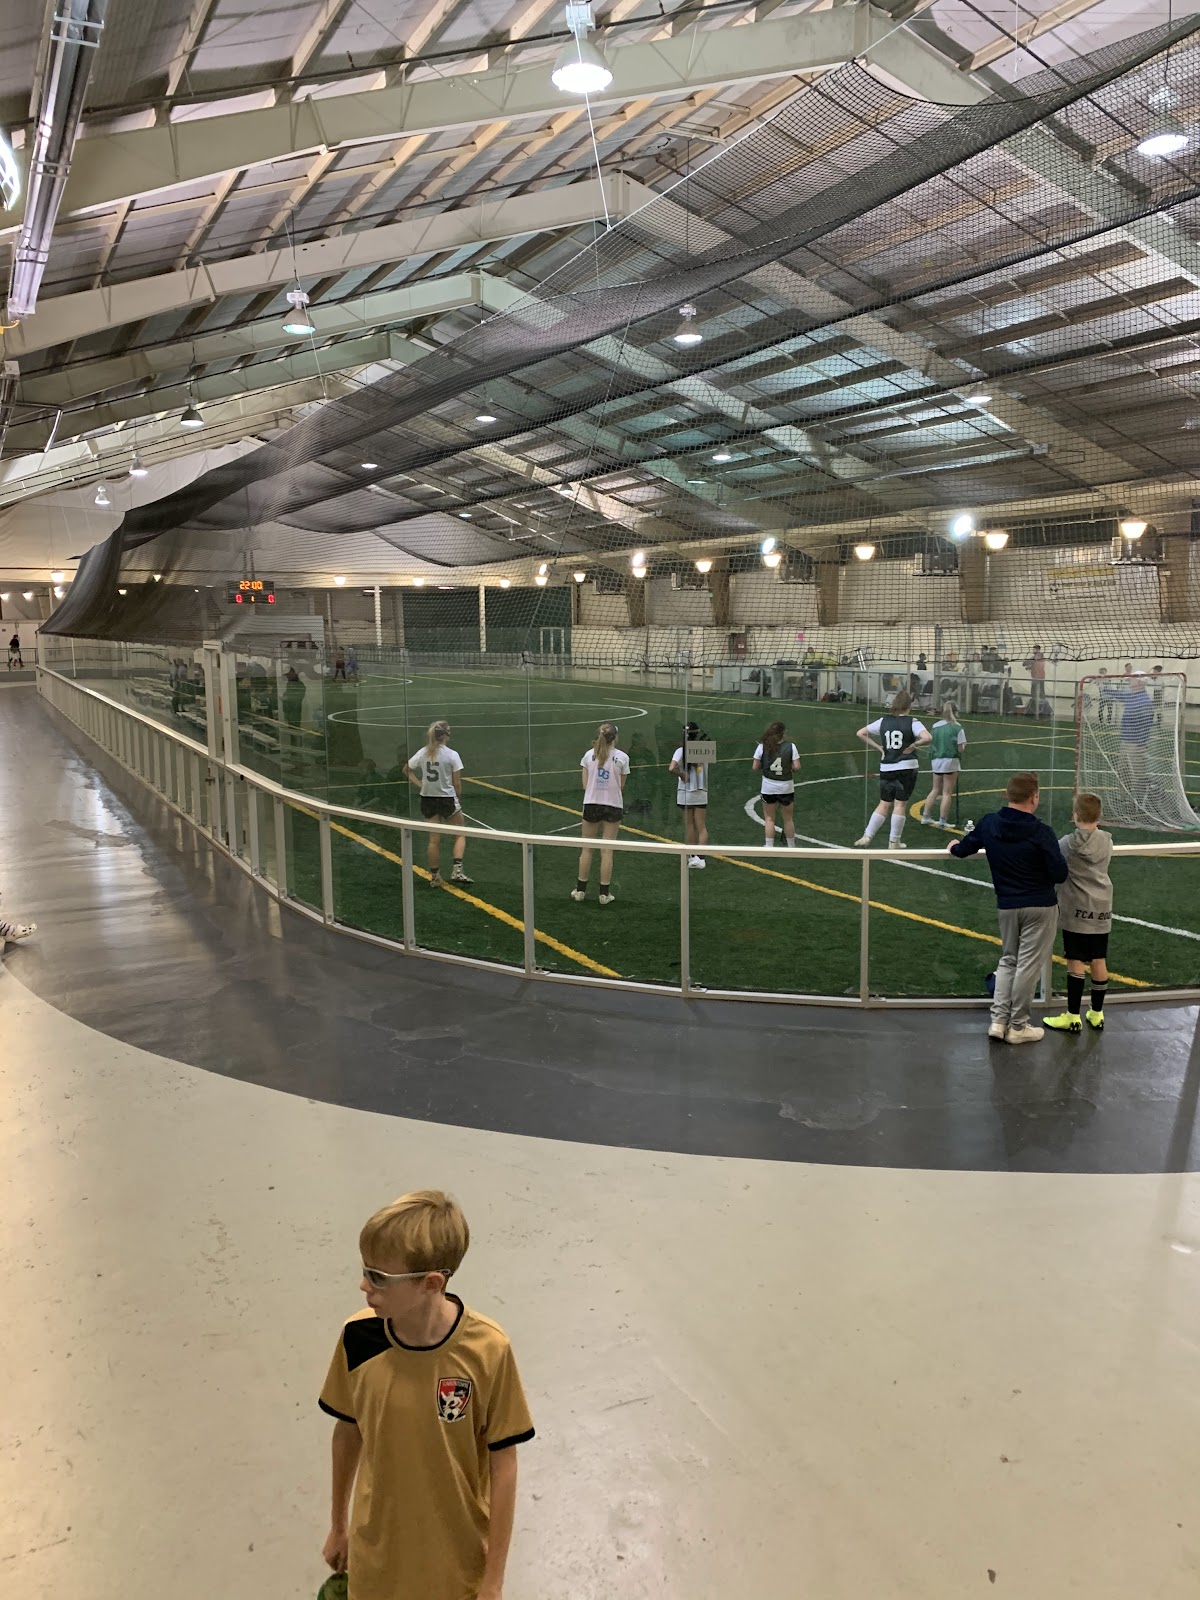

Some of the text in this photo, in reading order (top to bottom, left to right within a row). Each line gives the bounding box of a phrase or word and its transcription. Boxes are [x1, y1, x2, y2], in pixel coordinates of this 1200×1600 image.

[239, 580, 263, 590] 22:00
[884, 730, 903, 750] 18
[426, 761, 440, 782] 5
[769, 757, 783, 775] 4
[1075, 909, 1094, 920] FCA
